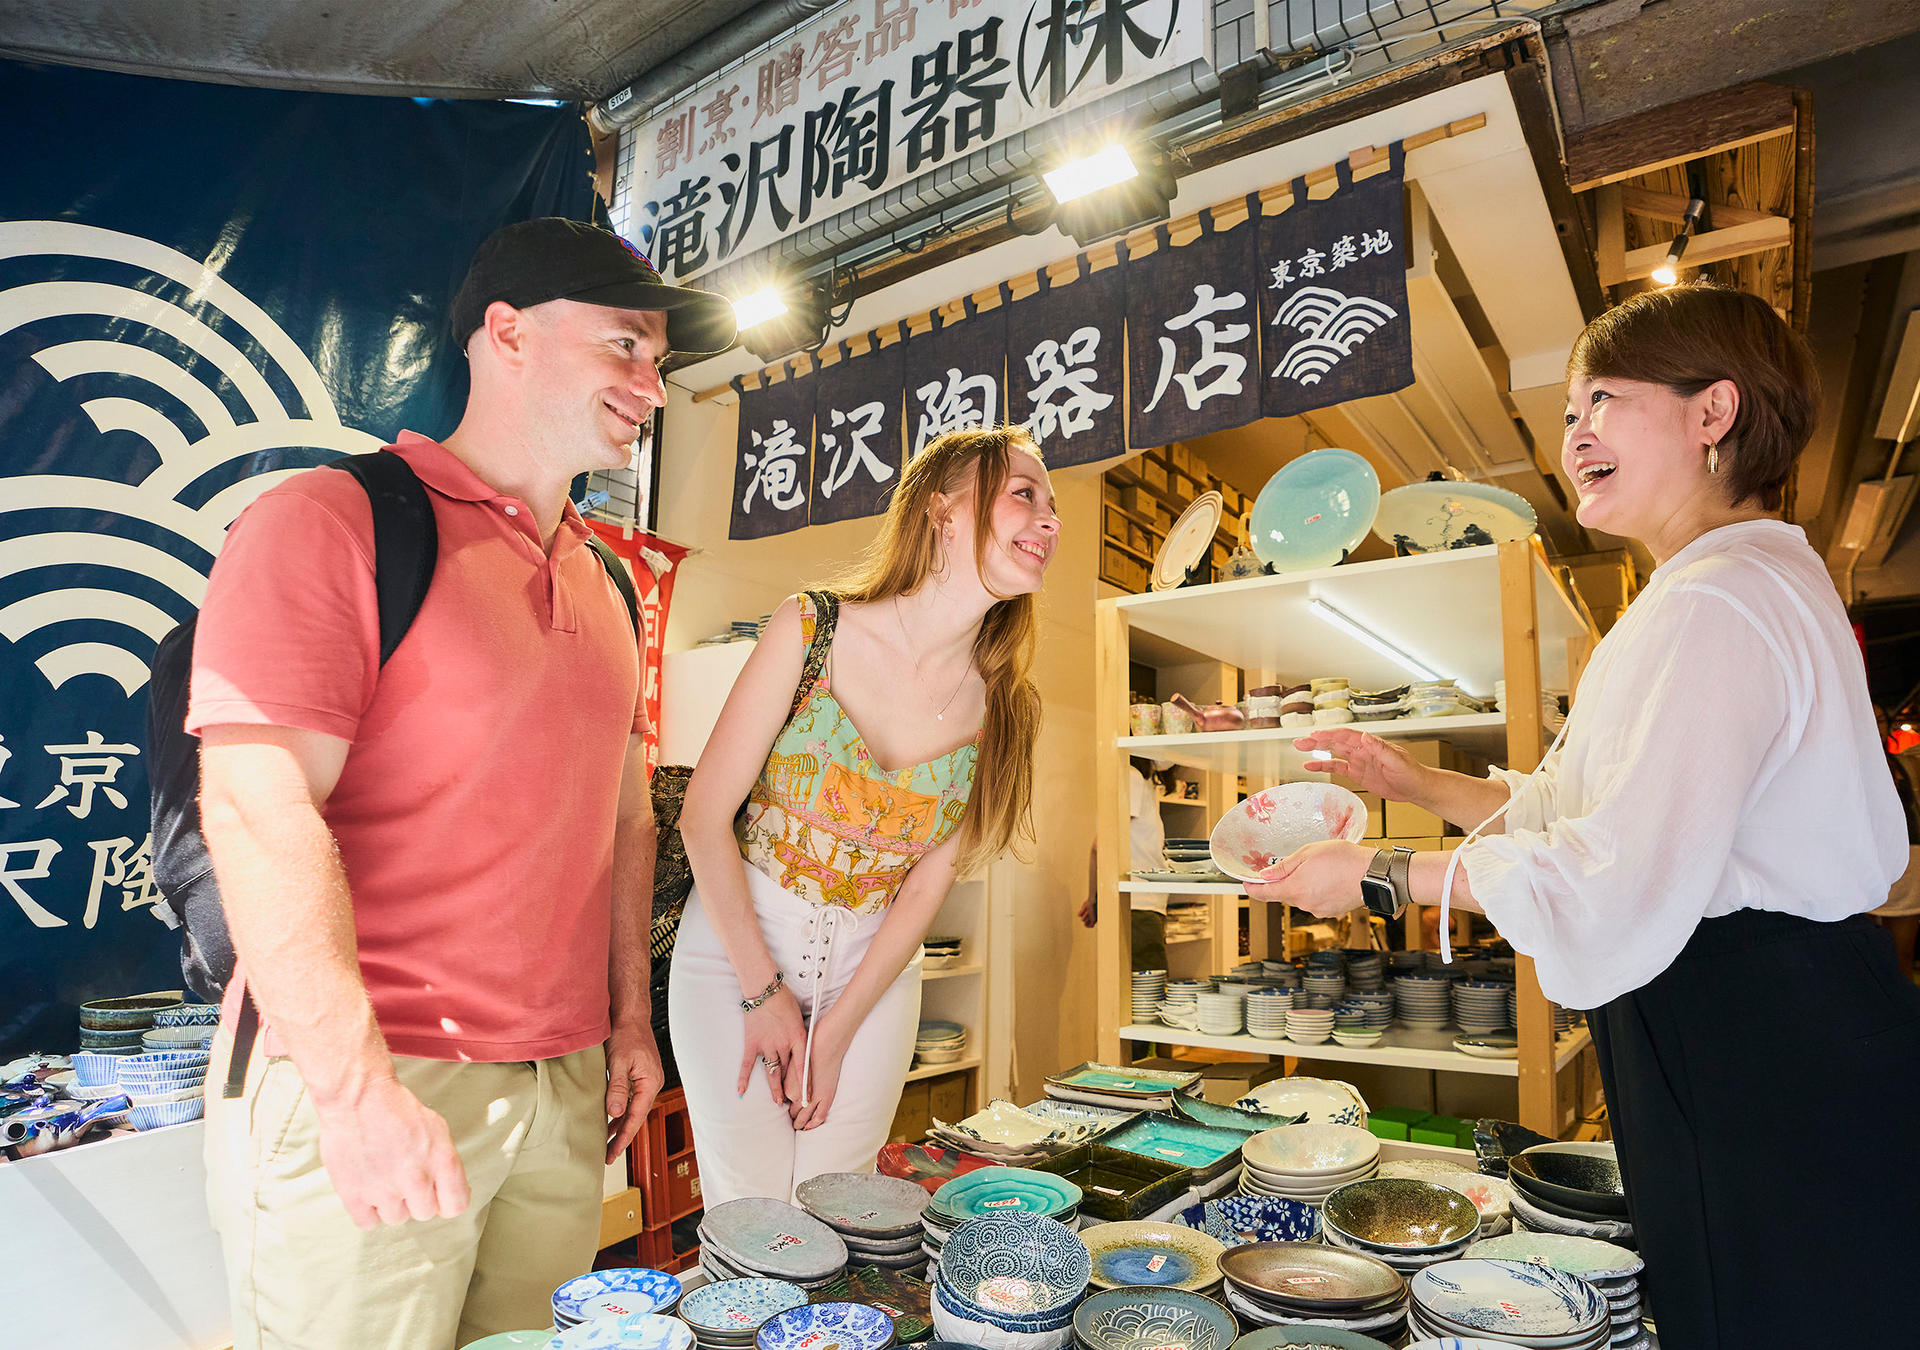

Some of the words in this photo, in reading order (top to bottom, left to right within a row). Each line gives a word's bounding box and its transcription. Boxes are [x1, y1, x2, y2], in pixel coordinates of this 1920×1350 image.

[610, 89, 629, 107] STOP
[656, 0, 983, 179] 割烹・贈答品
[1267, 228, 1394, 289] 東京築地
[0, 731, 141, 820] 京
